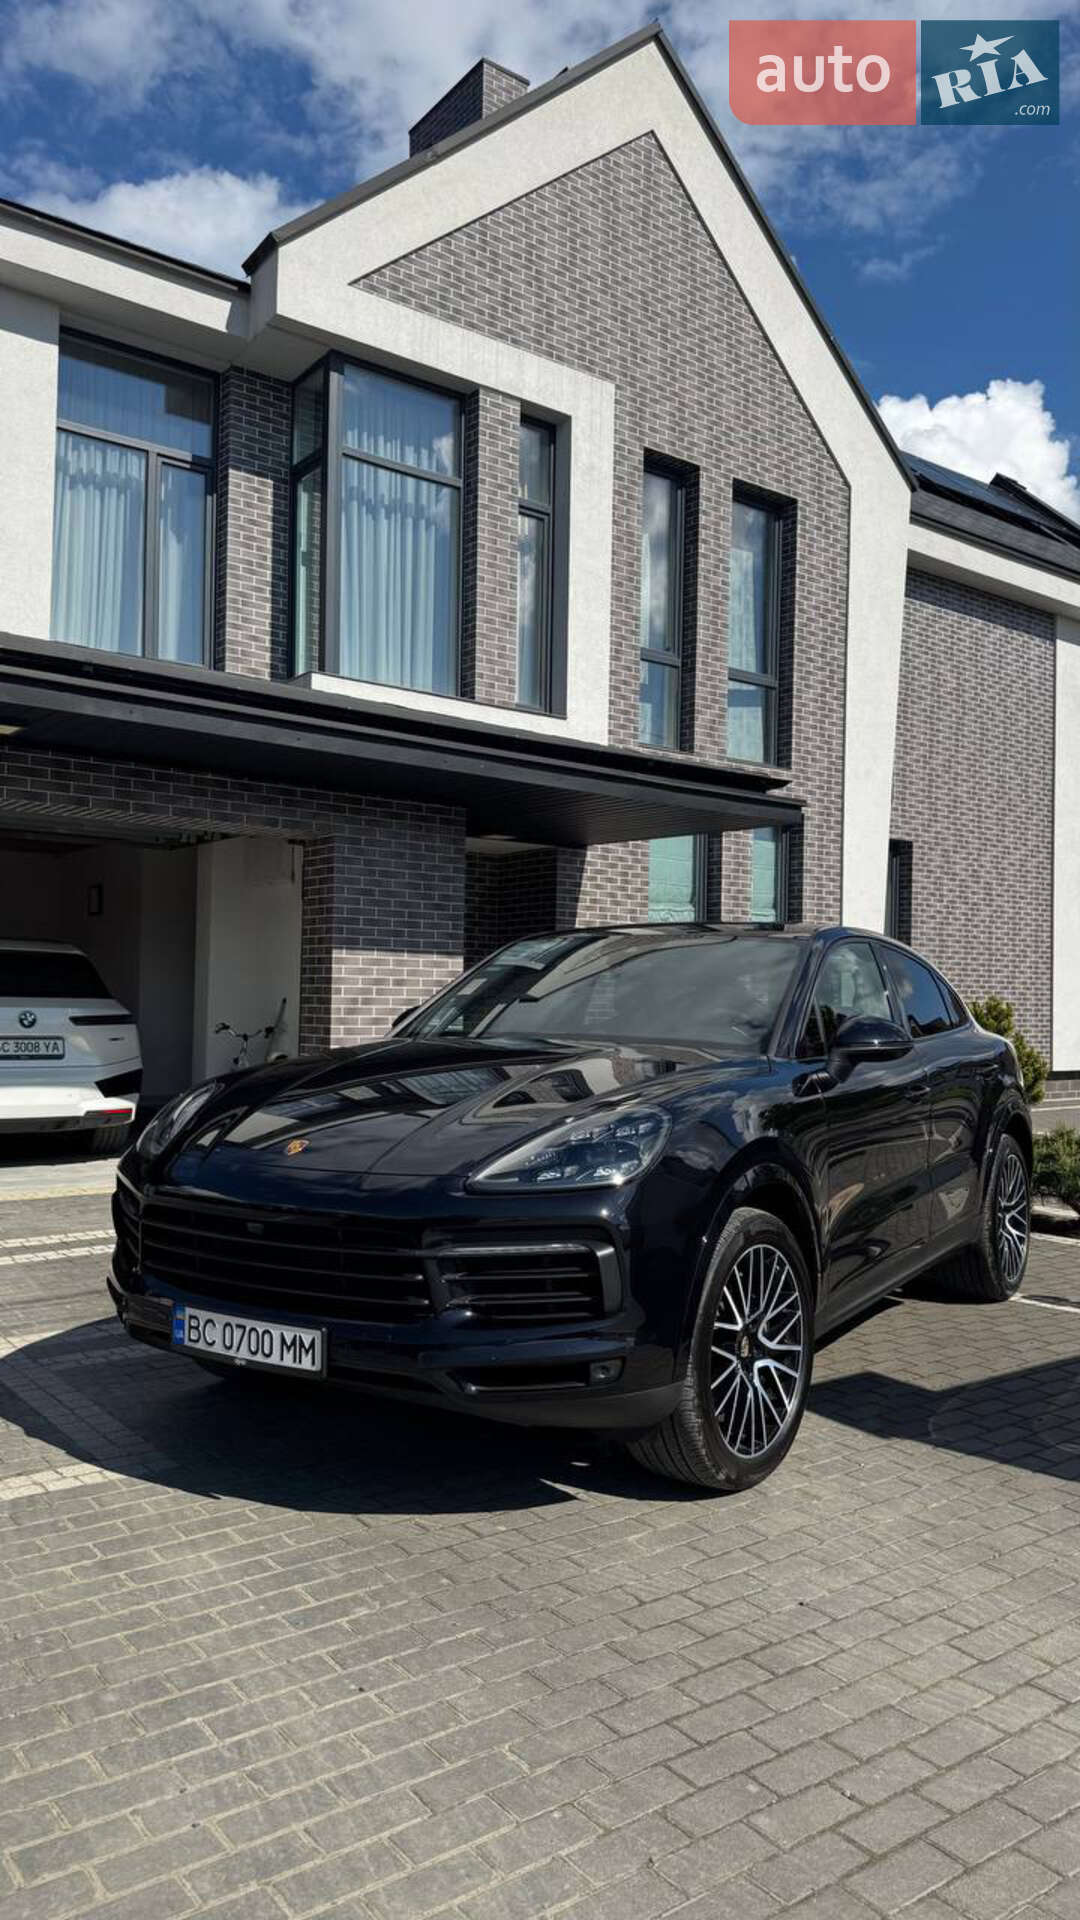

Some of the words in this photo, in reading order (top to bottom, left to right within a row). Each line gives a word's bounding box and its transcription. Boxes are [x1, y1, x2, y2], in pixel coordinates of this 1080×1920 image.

[0, 1042, 10, 1053] C
[13, 1042, 40, 1053] 3008
[43, 1042, 60, 1053] YA
[188, 1315, 217, 1347] BC
[222, 1322, 274, 1358] 0700
[280, 1331, 316, 1367] MM
